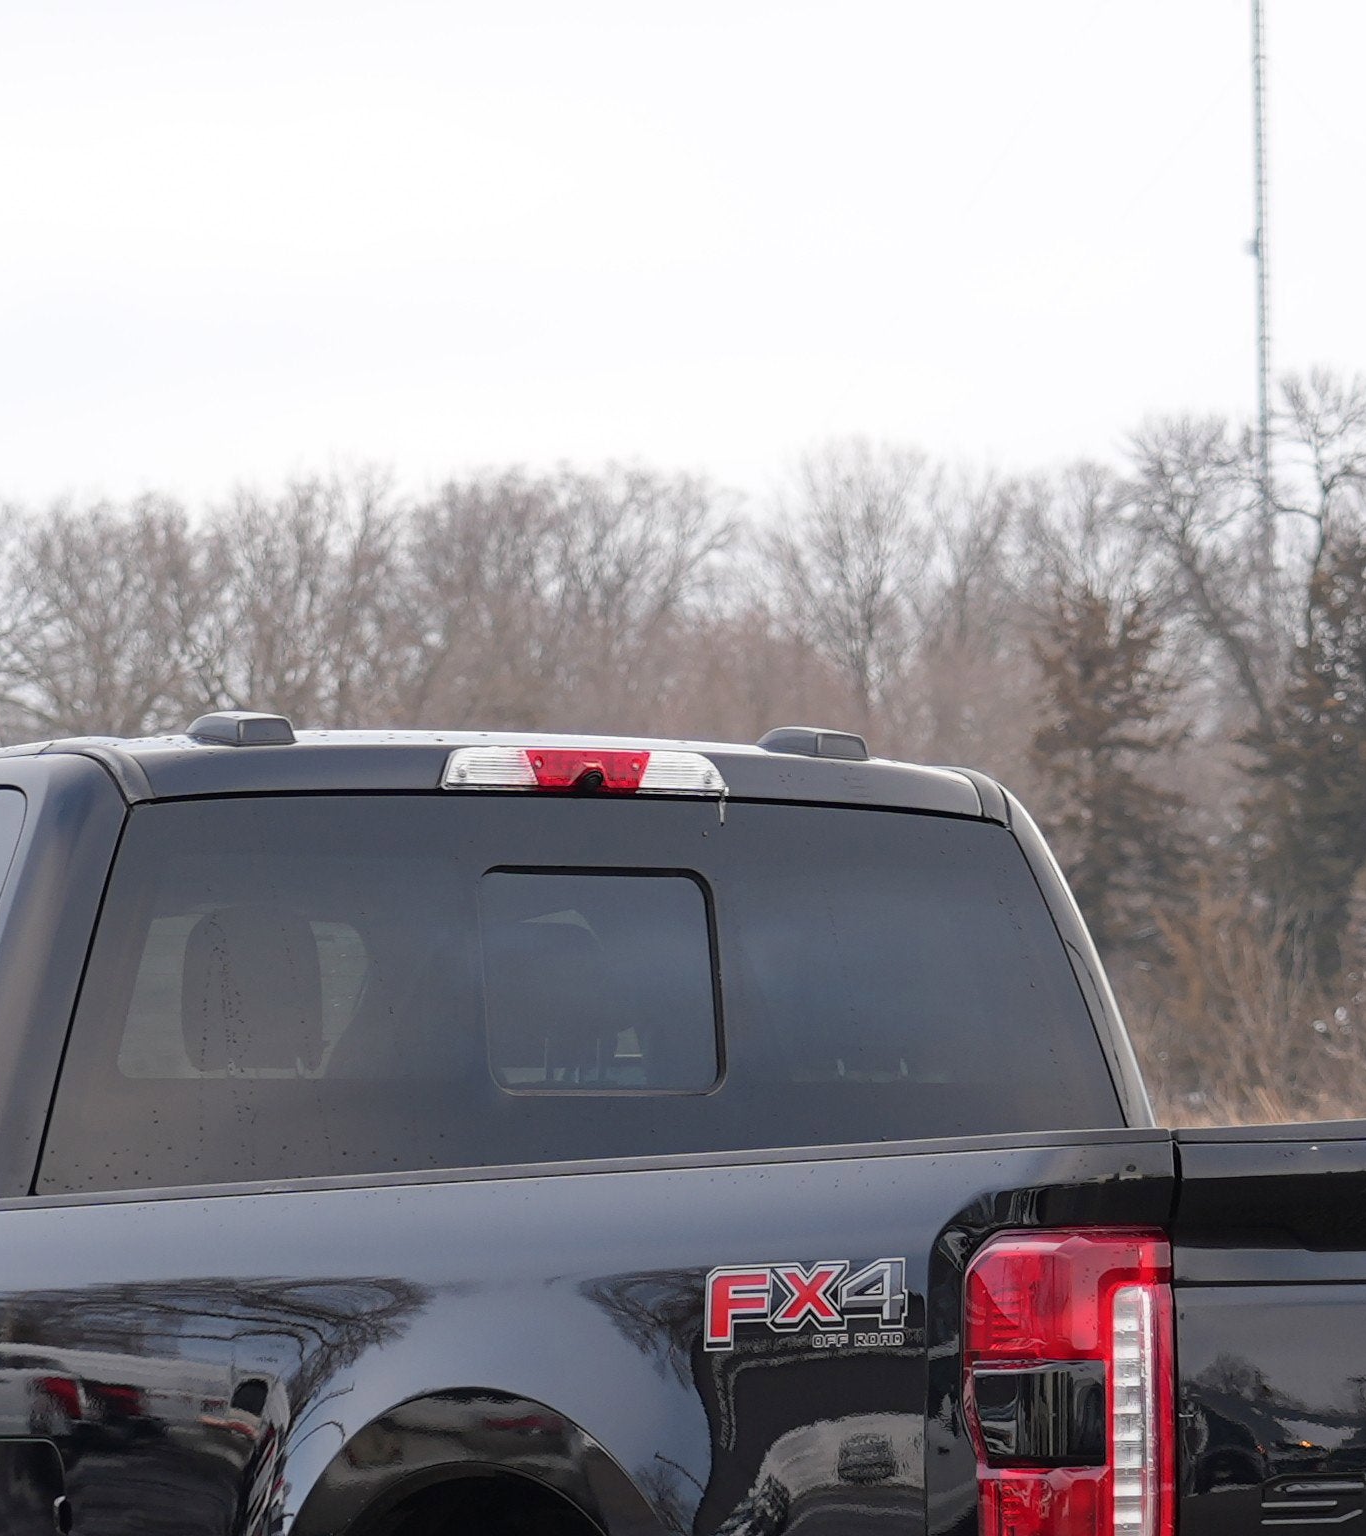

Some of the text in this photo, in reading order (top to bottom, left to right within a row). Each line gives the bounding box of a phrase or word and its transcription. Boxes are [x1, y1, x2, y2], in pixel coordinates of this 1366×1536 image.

[703, 1257, 908, 1352] FX4
[812, 1331, 905, 1348] OFF ROAD
